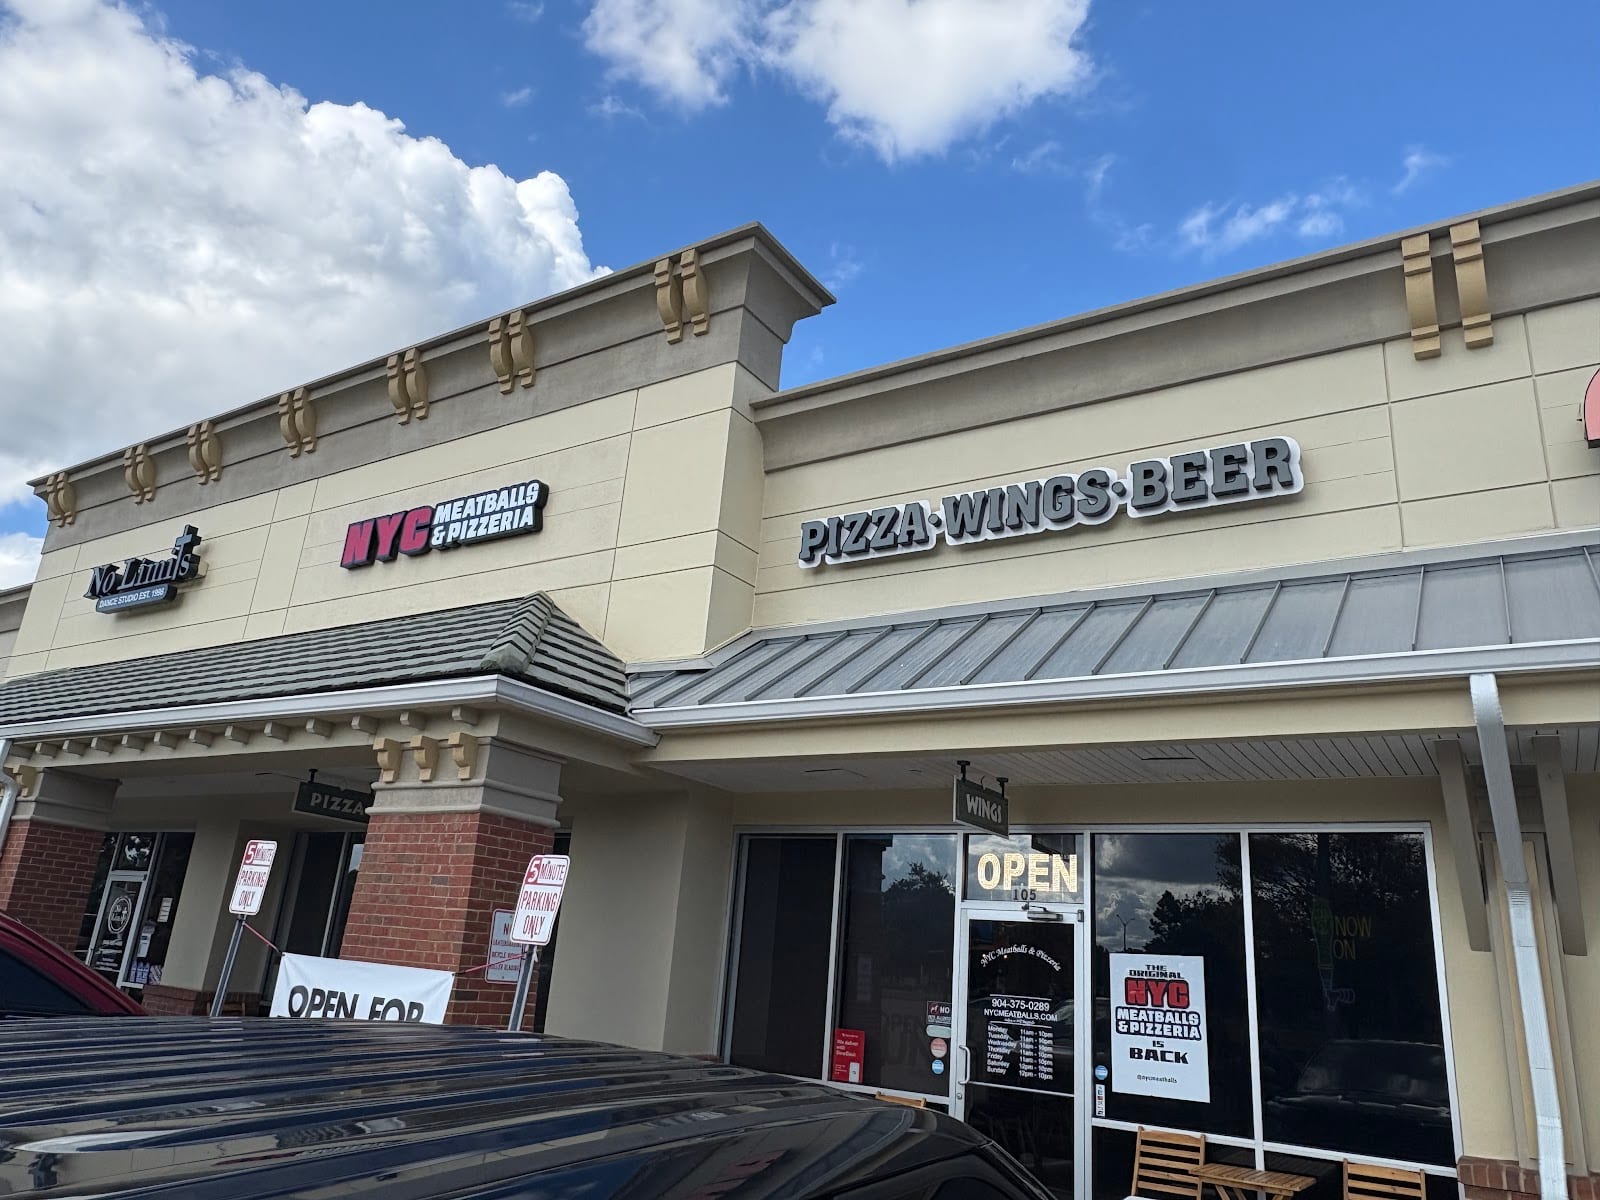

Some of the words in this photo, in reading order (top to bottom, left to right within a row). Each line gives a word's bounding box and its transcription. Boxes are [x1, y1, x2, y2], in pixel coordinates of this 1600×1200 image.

[433, 482, 540, 526] MEATBALLS
[800, 502, 930, 562] PIZZA
[941, 470, 1115, 538] WINGS
[1131, 438, 1293, 510] BEER
[341, 506, 433, 566] NYC
[84, 564, 117, 600] No
[116, 525, 198, 590] Limits
[99, 597, 118, 608] DANCE
[118, 593, 138, 604] STUDIO
[309, 791, 366, 816] PIZZA
[245, 844, 256, 864] 5
[254, 848, 274, 862] MINUTE
[239, 870, 267, 888] PARKING
[528, 860, 540, 883] 5
[539, 863, 566, 881] MINUTE
[977, 852, 1078, 893] OPEN
[239, 890, 256, 907] ONLY
[520, 890, 558, 912] PARKING
[1013, 888, 1037, 901] 105
[522, 914, 546, 936] ONLY
[1334, 915, 1372, 937] NOW
[996, 944, 1028, 957] Meatballs
[1333, 938, 1356, 960] ON
[1129, 969, 1185, 980] ORIGINAL
[1145, 964, 1167, 972] THE
[1126, 978, 1189, 1008] NYC
[939, 1006, 950, 1014] NO
[991, 998, 1050, 1012] 904-375-0289
[983, 1008, 1058, 1022] NYCMEATBALLS.COM
[1116, 1008, 1200, 1026] MEATBALLS
[1152, 1040, 1165, 1048] IS
[987, 1052, 1003, 1061] Friday
[1129, 1047, 1189, 1065] BACK
[1136, 1074, 1178, 1084] @nycmeatballs
